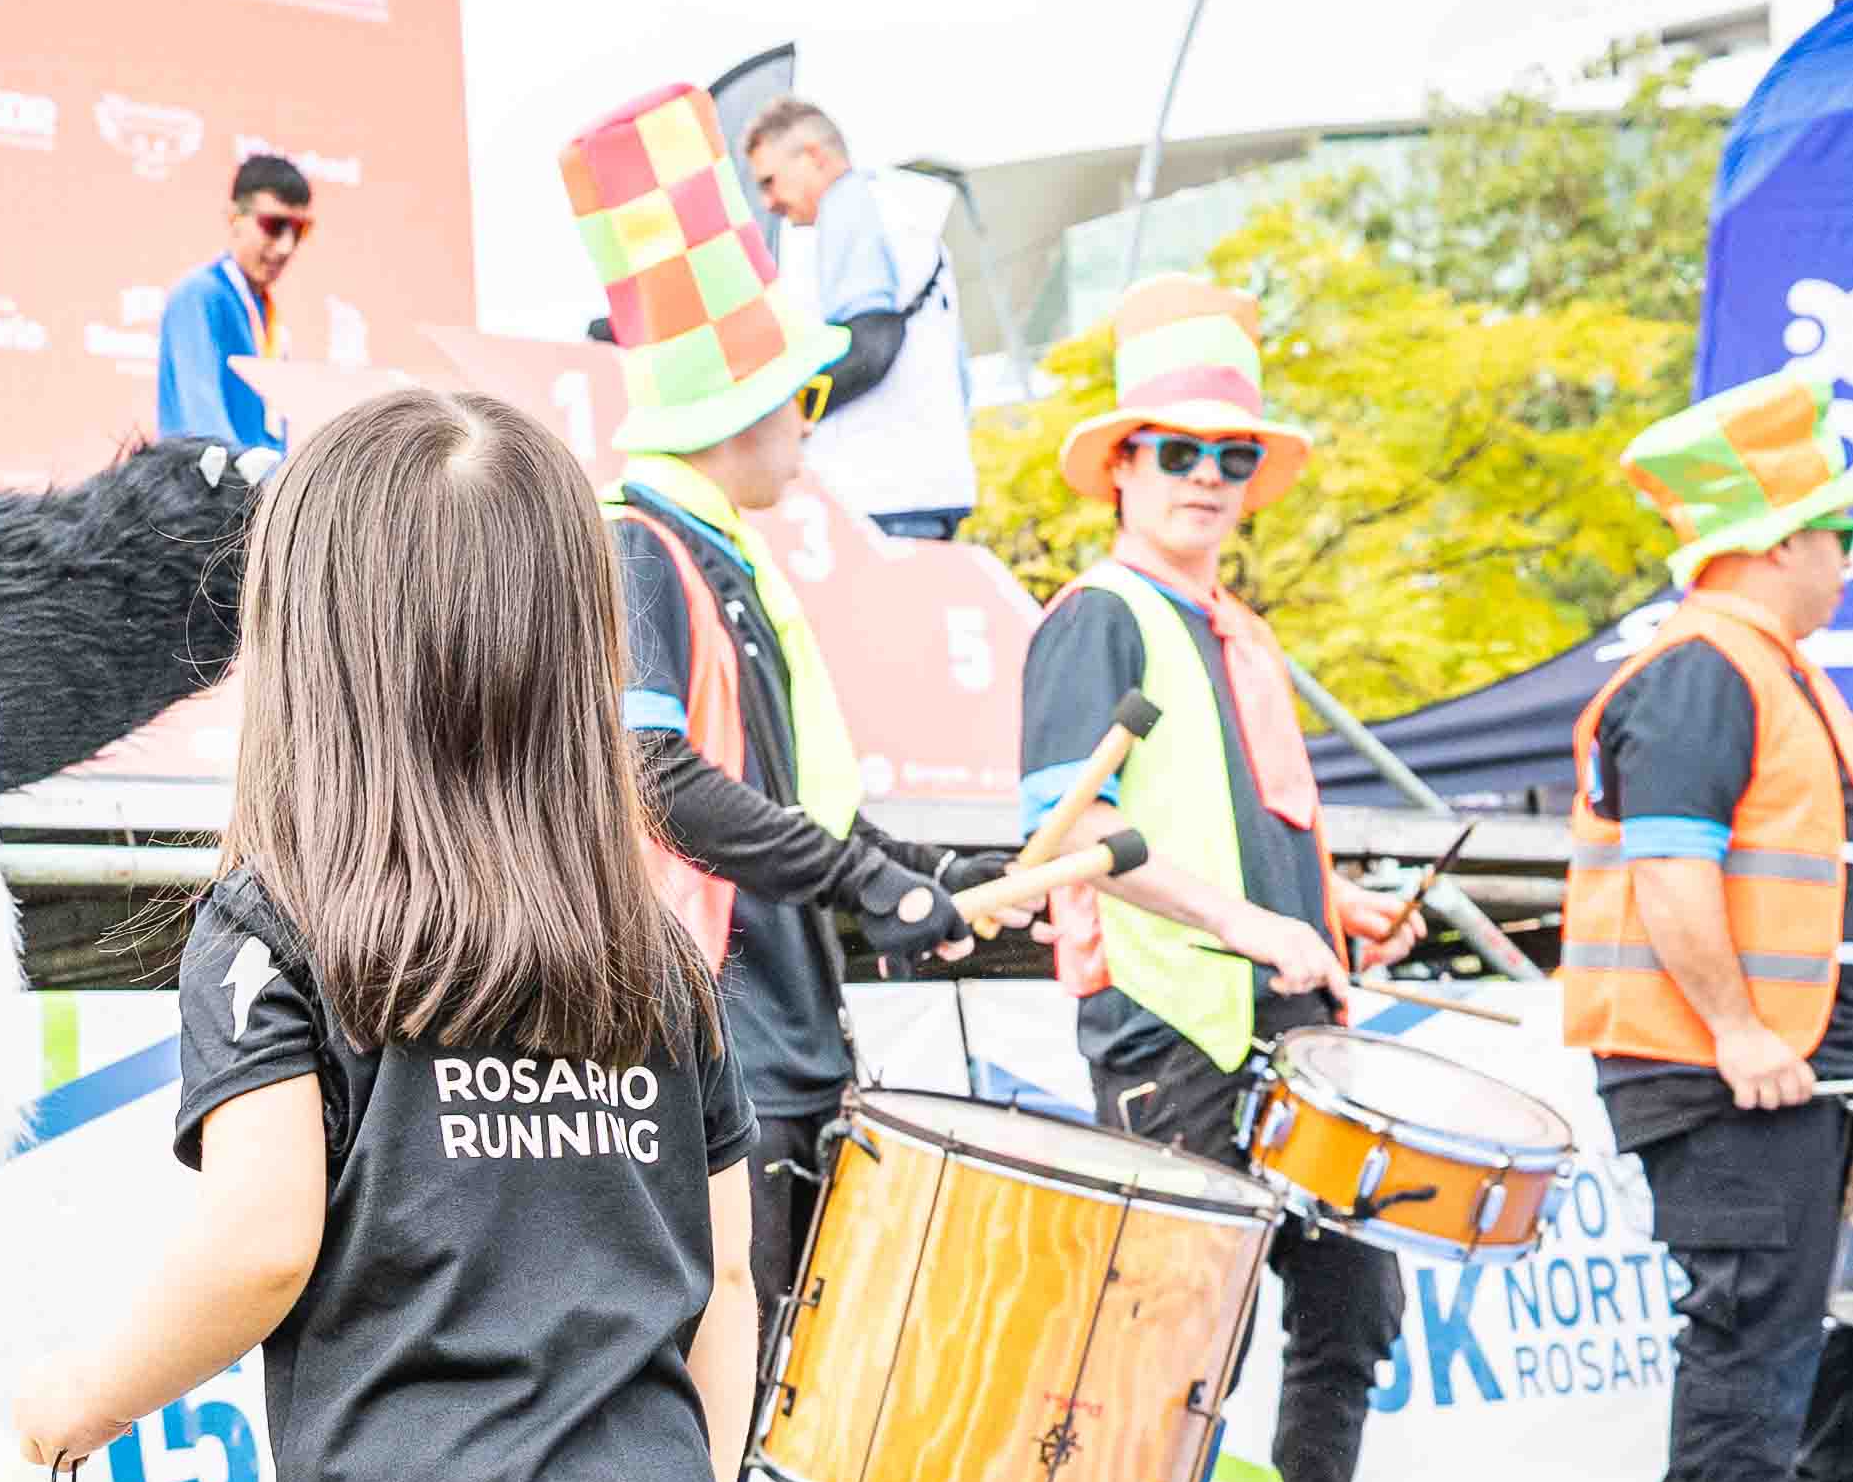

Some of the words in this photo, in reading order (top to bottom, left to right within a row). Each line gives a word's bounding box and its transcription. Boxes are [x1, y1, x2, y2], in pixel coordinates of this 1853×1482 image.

[552, 370, 597, 466] 1
[944, 605, 995, 692] 5
[434, 1057, 659, 1110] ROSARIO
[440, 1111, 660, 1164] RUNNING
